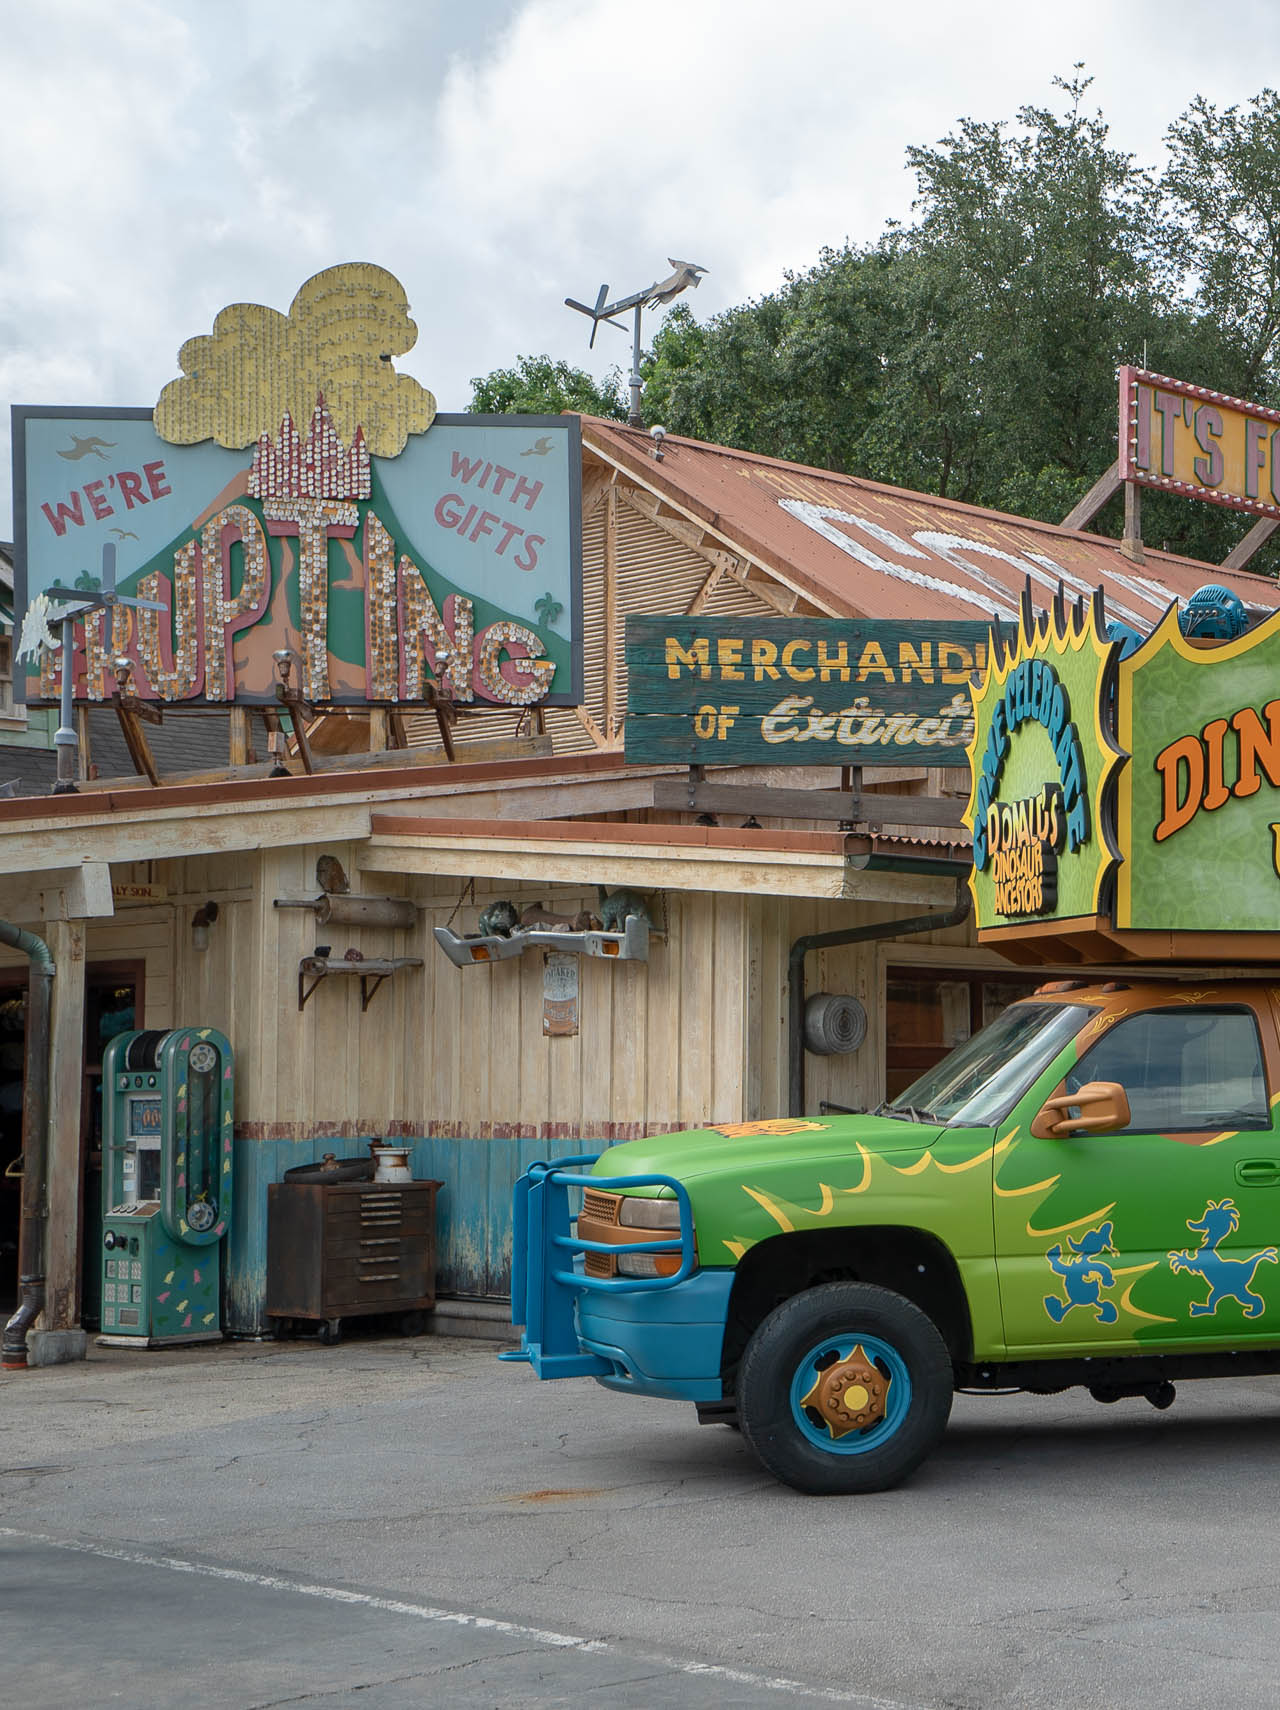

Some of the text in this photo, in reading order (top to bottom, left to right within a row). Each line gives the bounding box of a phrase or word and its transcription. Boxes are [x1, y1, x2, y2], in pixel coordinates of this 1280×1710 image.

[1135, 385, 1224, 488] IT'S
[41, 460, 172, 537] WE'RE
[450, 450, 546, 511] WITH
[433, 492, 547, 573] GIFTS
[665, 637, 988, 685] MERCHANDI
[693, 693, 976, 746] OF Extinct
[973, 659, 1087, 872] COME CELEBRATE
[987, 784, 1058, 855] DONALD'S
[992, 843, 1044, 884] DINOSAUR
[993, 876, 1043, 915] ANCESTORS
